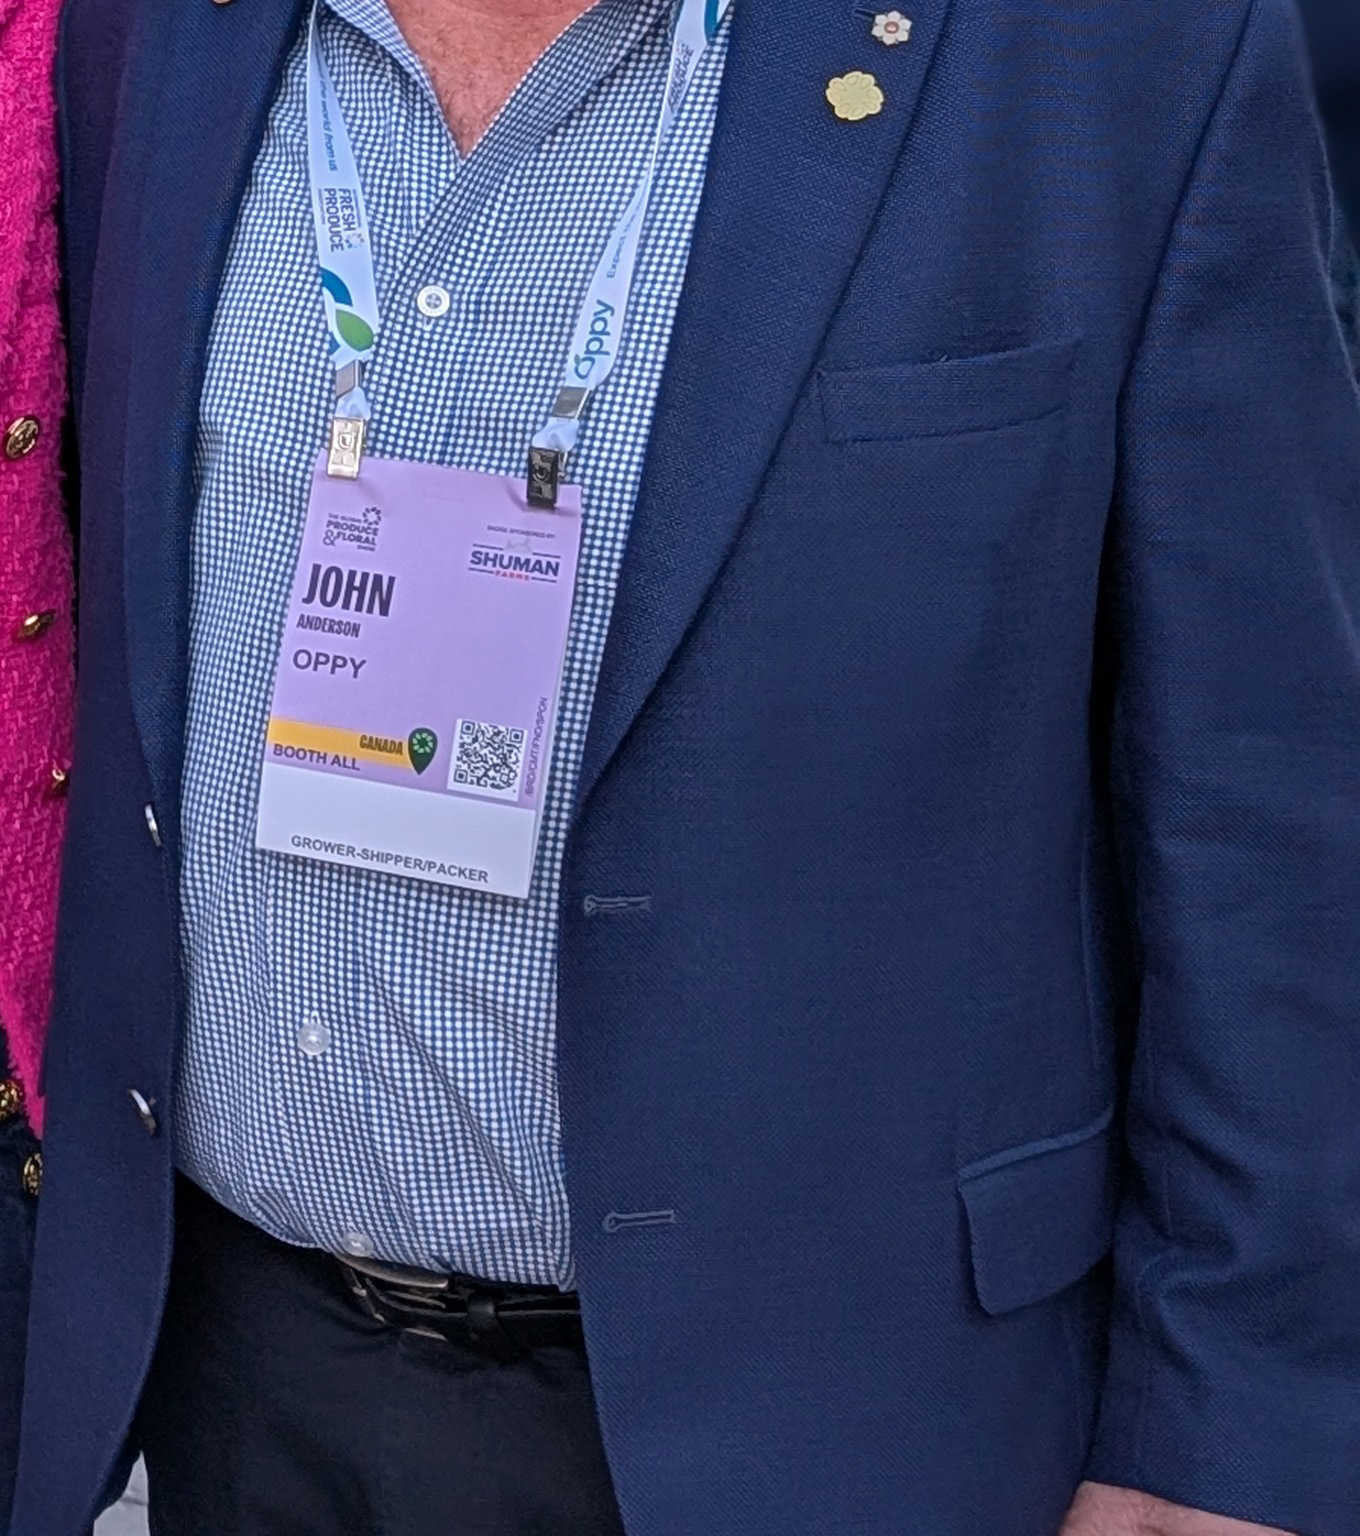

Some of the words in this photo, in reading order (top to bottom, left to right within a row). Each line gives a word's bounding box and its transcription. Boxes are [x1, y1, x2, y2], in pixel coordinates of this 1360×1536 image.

[324, 188, 344, 253] PRODUCE
[338, 188, 356, 232] FRESH
[573, 299, 615, 380] Oppy
[326, 520, 379, 536] PRODUCE
[336, 531, 377, 546] FLORAL
[469, 550, 560, 577] SHUMAN
[301, 562, 396, 617] JOHN
[296, 614, 361, 638] ANDERSON
[292, 649, 367, 679] OPPY
[273, 743, 327, 765] BOOTH
[330, 754, 361, 772] ALL
[359, 734, 404, 756] CANADA
[291, 834, 489, 884] GROWER-SHIPPER/PACKER
